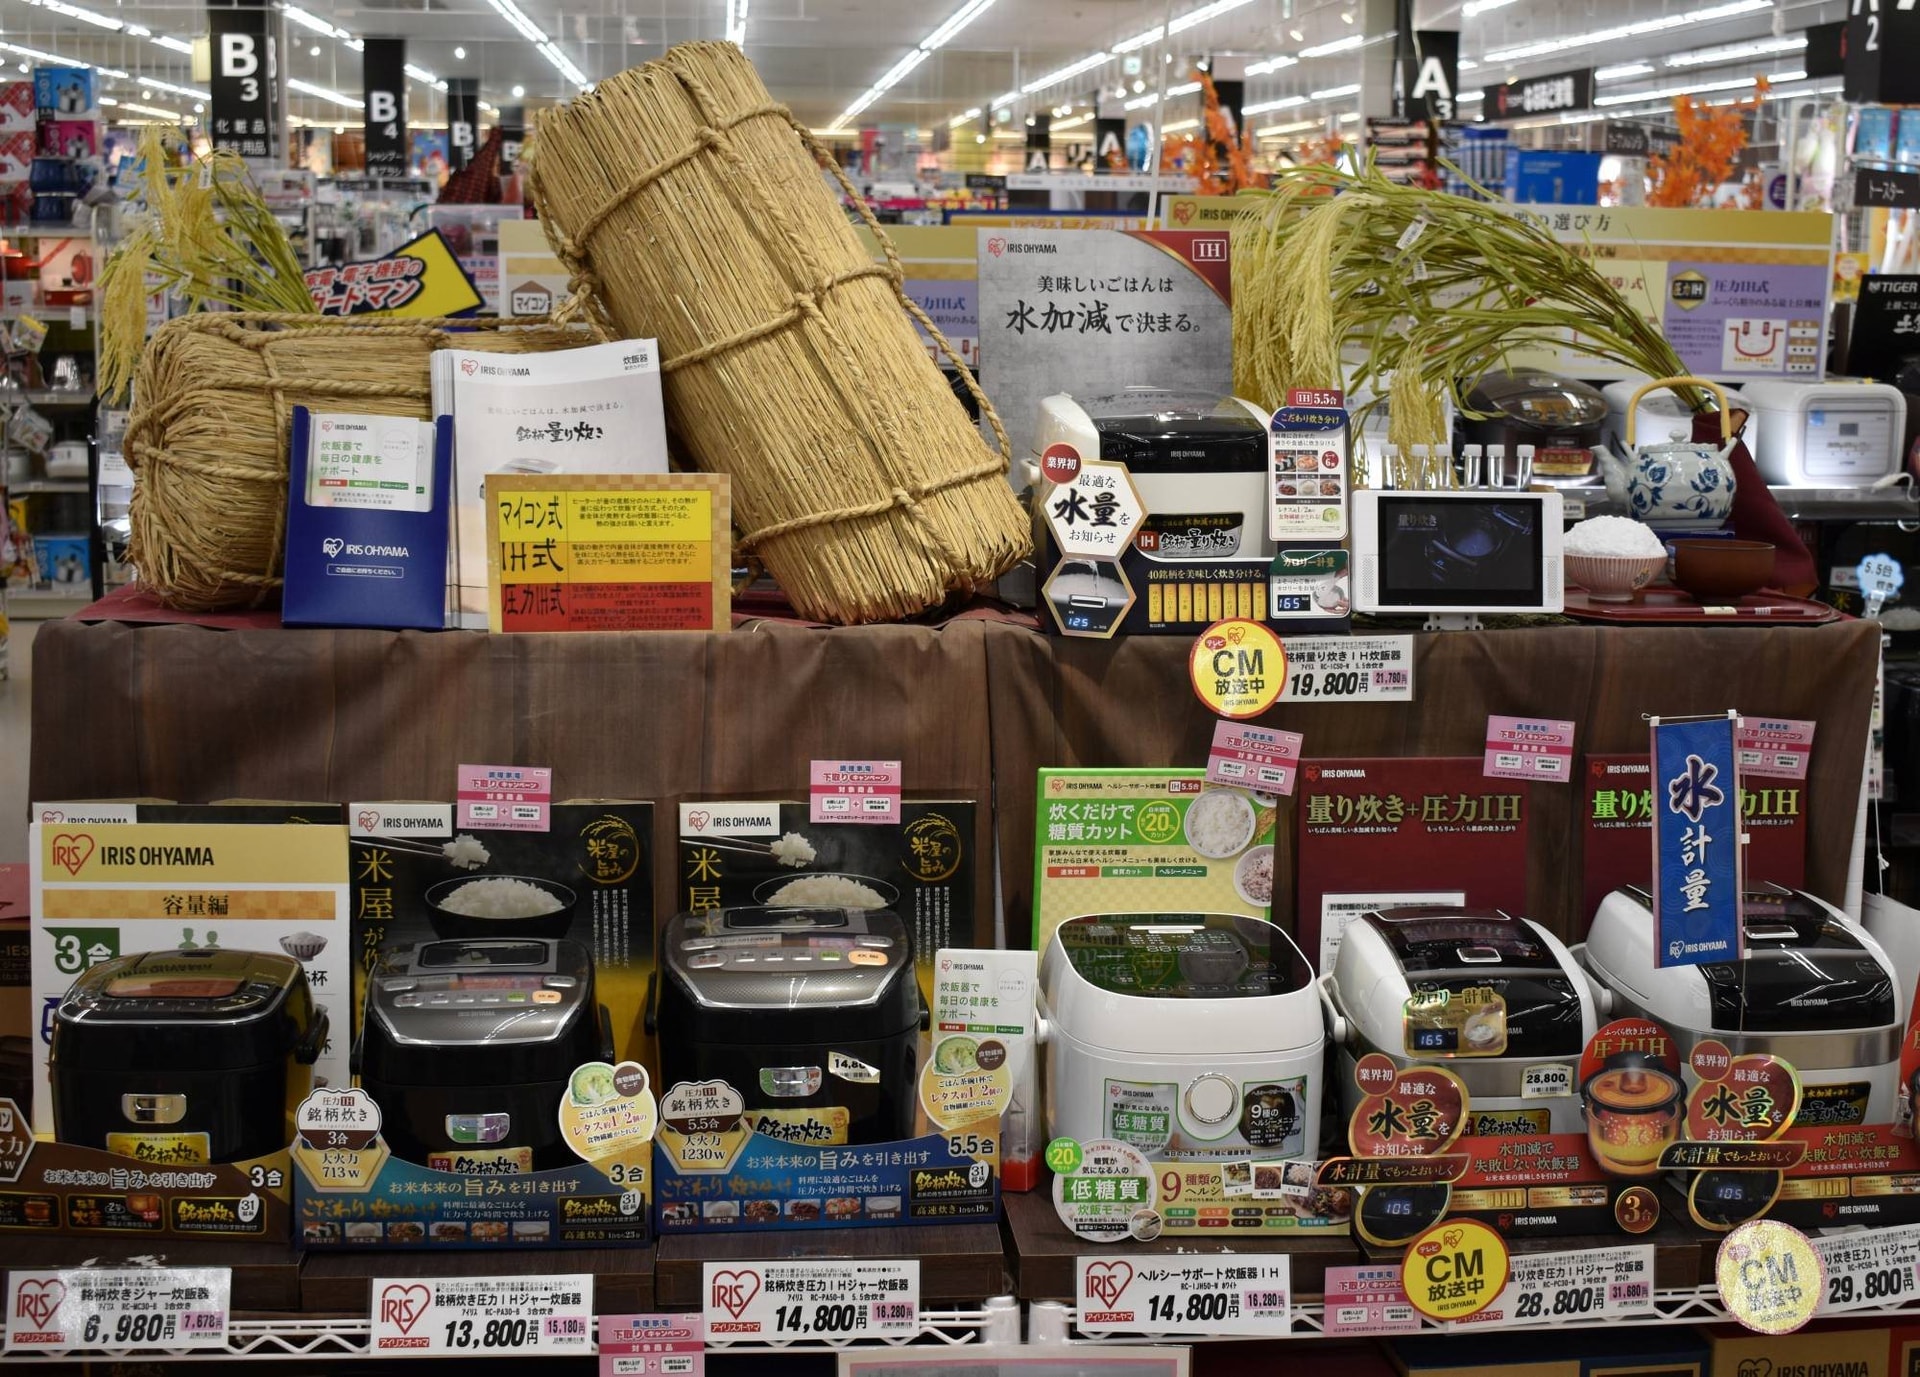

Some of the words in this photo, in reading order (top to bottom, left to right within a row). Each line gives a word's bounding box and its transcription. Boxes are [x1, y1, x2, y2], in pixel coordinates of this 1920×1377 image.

[1865, 15, 1879, 51] 2
[221, 33, 258, 77] B
[1412, 57, 1451, 99] A
[240, 78, 259, 101] 3
[371, 91, 398, 122] B
[1436, 99, 1452, 120] 3
[216, 119, 266, 134] 化粧品
[383, 124, 399, 139] 4
[452, 121, 473, 146] B
[1028, 150, 1047, 170] A
[1007, 243, 1022, 253] IRIS
[1024, 244, 1057, 254] OHYAMA
[1198, 243, 1221, 258] IH
[305, 256, 421, 288] 家電・電子機器の
[1037, 276, 1174, 293] 美味しいごはんは
[1881, 282, 1918, 293] TIGER
[1006, 300, 1201, 335] 水加減で決まる。
[622, 354, 648, 366] 炊飯器
[1298, 392, 1312, 404] IH
[1313, 393, 1338, 406] 5.5合
[1280, 413, 1340, 425] こだわり炊き分け
[320, 441, 363, 451] 炊飯器で
[320, 453, 383, 465] 毎日の健康を
[1046, 456, 1077, 471] 業界初
[320, 466, 360, 476] サポート
[1079, 473, 1117, 489] 最適な
[499, 495, 563, 530] マイコン式
[1053, 488, 1131, 527] 水量を
[1068, 530, 1117, 545] お知らせ
[1140, 535, 1154, 547] IH
[346, 544, 363, 555] IRIS
[364, 545, 409, 558] OHYAMA
[501, 537, 564, 572] IH式
[1147, 569, 1265, 580] 40銘柄を美味しく炊き分ける。
[1278, 595, 1300, 609] 165
[1067, 617, 1090, 628] 125
[1213, 648, 1264, 677] CM
[1214, 678, 1266, 696] 放送中
[1525, 734, 1562, 742] キャンペーン
[1251, 741, 1289, 753] キャンペーン
[823, 772, 849, 782] 下取り
[850, 773, 890, 782] キャンペーン
[1321, 769, 1336, 778] IRIS
[1337, 769, 1366, 779] OHYAMA
[1607, 765, 1622, 774] IRIS
[1622, 765, 1649, 774] OHYAMA
[498, 781, 538, 789] キャンペーン
[1078, 782, 1103, 790] OHYAMA
[1170, 782, 1180, 791] IH
[1181, 782, 1200, 791] 5.5合
[1048, 803, 1135, 821] 炊くだけで
[1307, 794, 1522, 824] 量り炊き+圧力IH
[383, 817, 402, 829] IRIS
[403, 817, 443, 829] OHYAMA
[713, 817, 731, 828] IRIS
[732, 817, 772, 827] OHYAMA
[1048, 823, 1133, 841] 糖質カット
[1668, 754, 1724, 912] 水計量
[587, 838, 628, 858] 米屋の
[910, 837, 951, 857] 米屋の
[101, 847, 136, 866] IRIS
[139, 847, 214, 866] OHYAMA
[1159, 867, 1203, 876] ヘルシーメニュー
[162, 895, 229, 916] 容量編
[1685, 943, 1698, 953] IRIS
[1698, 940, 1728, 952] OHYAMA
[940, 982, 980, 993] 炊飯器で
[939, 996, 999, 1007] 毎日の健康を
[1414, 988, 1495, 1006] カロリー計量
[1790, 999, 1803, 1007] IRIS
[1803, 999, 1828, 1007] OHYAMA
[939, 1009, 977, 1020] サポート
[1420, 1034, 1443, 1046] 165
[1694, 1054, 1728, 1067] 業界初
[1359, 1069, 1393, 1082] 業界初
[1526, 1072, 1567, 1084] 28,800
[1733, 1068, 1771, 1082] 最適な
[1399, 1082, 1436, 1095] 最適な
[670, 1096, 733, 1113] 銘柄炊き
[1703, 1084, 1783, 1128] 水量を
[307, 1107, 369, 1122] 銘柄炊き
[1368, 1099, 1450, 1139] 水量を
[687, 1117, 720, 1131] 5.5合
[757, 1117, 833, 1143] 銘柄炊き
[1114, 1113, 1166, 1132] 低糖質
[327, 1131, 349, 1145] 3合
[1707, 1128, 1757, 1141] お知らせ
[1823, 1133, 1876, 1146] 水加減で
[135, 1141, 200, 1164] 銘柄炊き
[949, 1134, 995, 1156] 5.5合
[1372, 1142, 1425, 1157] お知らせ
[1499, 1141, 1554, 1156] 水加減で
[746, 1150, 932, 1171] お米本来の旨みを引き出す
[1671, 1147, 1793, 1165] 水計量でもっとおいしく
[1802, 1144, 1901, 1162] 失敗しない炊飯器
[1094, 1157, 1118, 1165] 糖質が
[1474, 1155, 1580, 1173] 失敗しない炊飯器
[251, 1167, 283, 1187] 3合
[610, 1164, 644, 1184] 3合
[971, 1165, 984, 1176] 31
[1082, 1166, 1129, 1175] 気になる人の
[1329, 1159, 1455, 1181] 水計量でもっとおいしく
[44, 1168, 216, 1189] お米本来の旨みを引き出す
[915, 1171, 967, 1190] 銘柄炊き
[1185, 1174, 1221, 1187] 種類の
[389, 1178, 582, 1197] お米本来の旨みを引き出す
[1070, 1179, 1140, 1201] 低糖質
[1161, 1171, 1182, 1203] 9
[1717, 1185, 1743, 1200] 105
[622, 1193, 637, 1203] 31
[564, 1199, 617, 1216] 銘柄炊き
[916, 1203, 955, 1215] 高速炊き
[1077, 1204, 1132, 1215] 炊飯モード
[1383, 1202, 1411, 1215] 105
[1623, 1195, 1652, 1222] 3合
[1838, 1205, 1852, 1214] IRIS
[1852, 1203, 1880, 1213] OHYAMA
[1514, 1217, 1528, 1226] IRIS
[1528, 1215, 1557, 1225] OHYAMA
[1419, 1244, 1439, 1253] テレビ
[1137, 1267, 1280, 1280] ヘルシーサポート炊飯器IH
[1425, 1249, 1485, 1283] CM
[1740, 1251, 1799, 1290] CM
[764, 1279, 909, 1293] 銘柄炊き圧力IHジャー炊飯器
[1086, 1274, 1117, 1298] IRIS
[1428, 1279, 1486, 1302] 放送中
[81, 1287, 210, 1302] 銘柄炊きジャー炊飯器
[435, 1292, 582, 1306] 銘柄炊き圧力IHジャー炊飯器
[712, 1284, 743, 1308] IRIS
[851, 1292, 886, 1301] 5.5合炊き
[17, 1293, 49, 1318] IRIS
[381, 1298, 413, 1323] IRIS
[527, 1307, 554, 1316] 3合炊き
[1437, 1303, 1452, 1312] IRIS
[1451, 1299, 1477, 1310] OHYAMA
[1084, 1311, 1134, 1322] アイリスオーヤマ
[613, 1328, 644, 1340] 下取り
[645, 1328, 692, 1338] キャンペーン
[711, 1322, 761, 1333] アイリスオーヤマ
[379, 1338, 430, 1348] アイリスオーヤマ
[1809, 1362, 1868, 1377] OHYAMA
